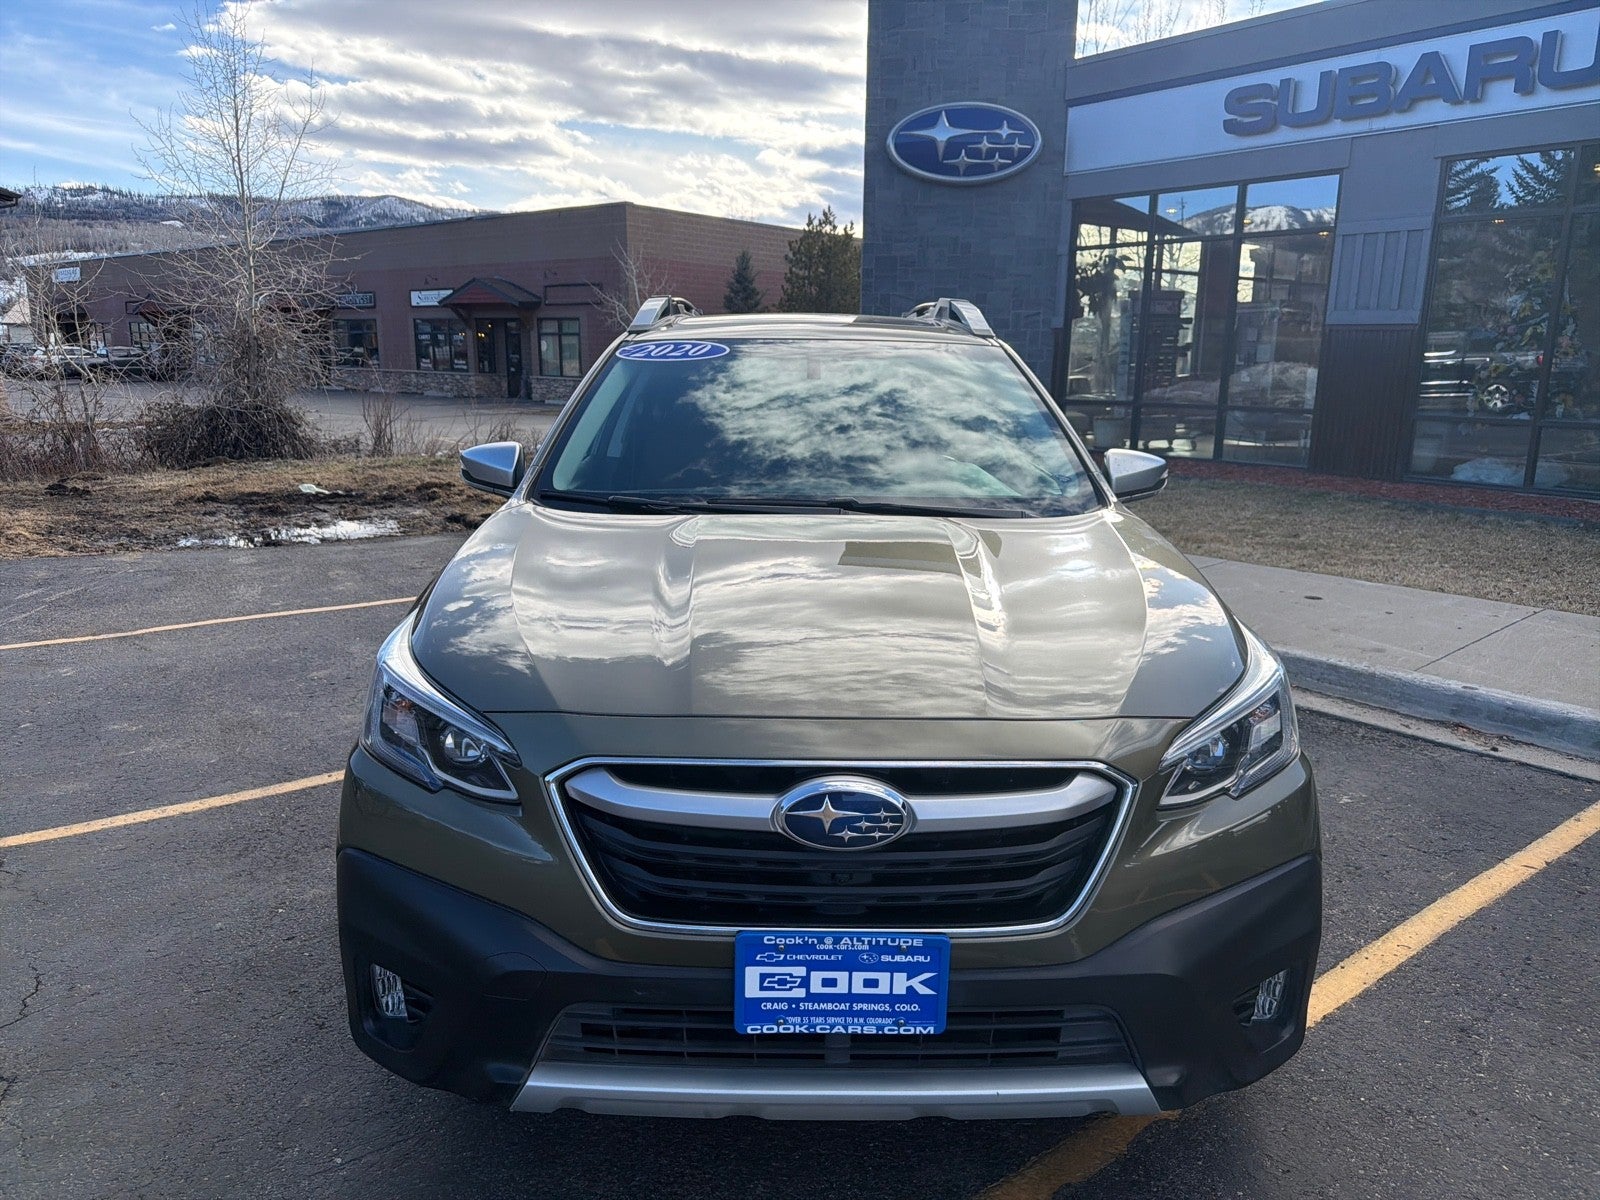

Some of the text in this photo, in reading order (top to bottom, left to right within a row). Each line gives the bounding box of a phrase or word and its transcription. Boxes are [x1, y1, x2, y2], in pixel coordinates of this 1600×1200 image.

[1222, 28, 1600, 137] SUBARU
[630, 344, 711, 357] 2020
[763, 936, 924, 947] Cook'n @ ALTITUDE
[880, 954, 931, 963] SUBARU
[745, 966, 938, 998] COOK
[761, 1002, 921, 1012] CRAIG STEAMBOAT SPRINGS, COLO.
[802, 1016, 809, 1024] 55
[810, 1016, 825, 1024] YEARS
[826, 1016, 846, 1024] SERVICE
[846, 1017, 853, 1025] TO
[746, 1024, 935, 1035] COOK-CARS.COM
